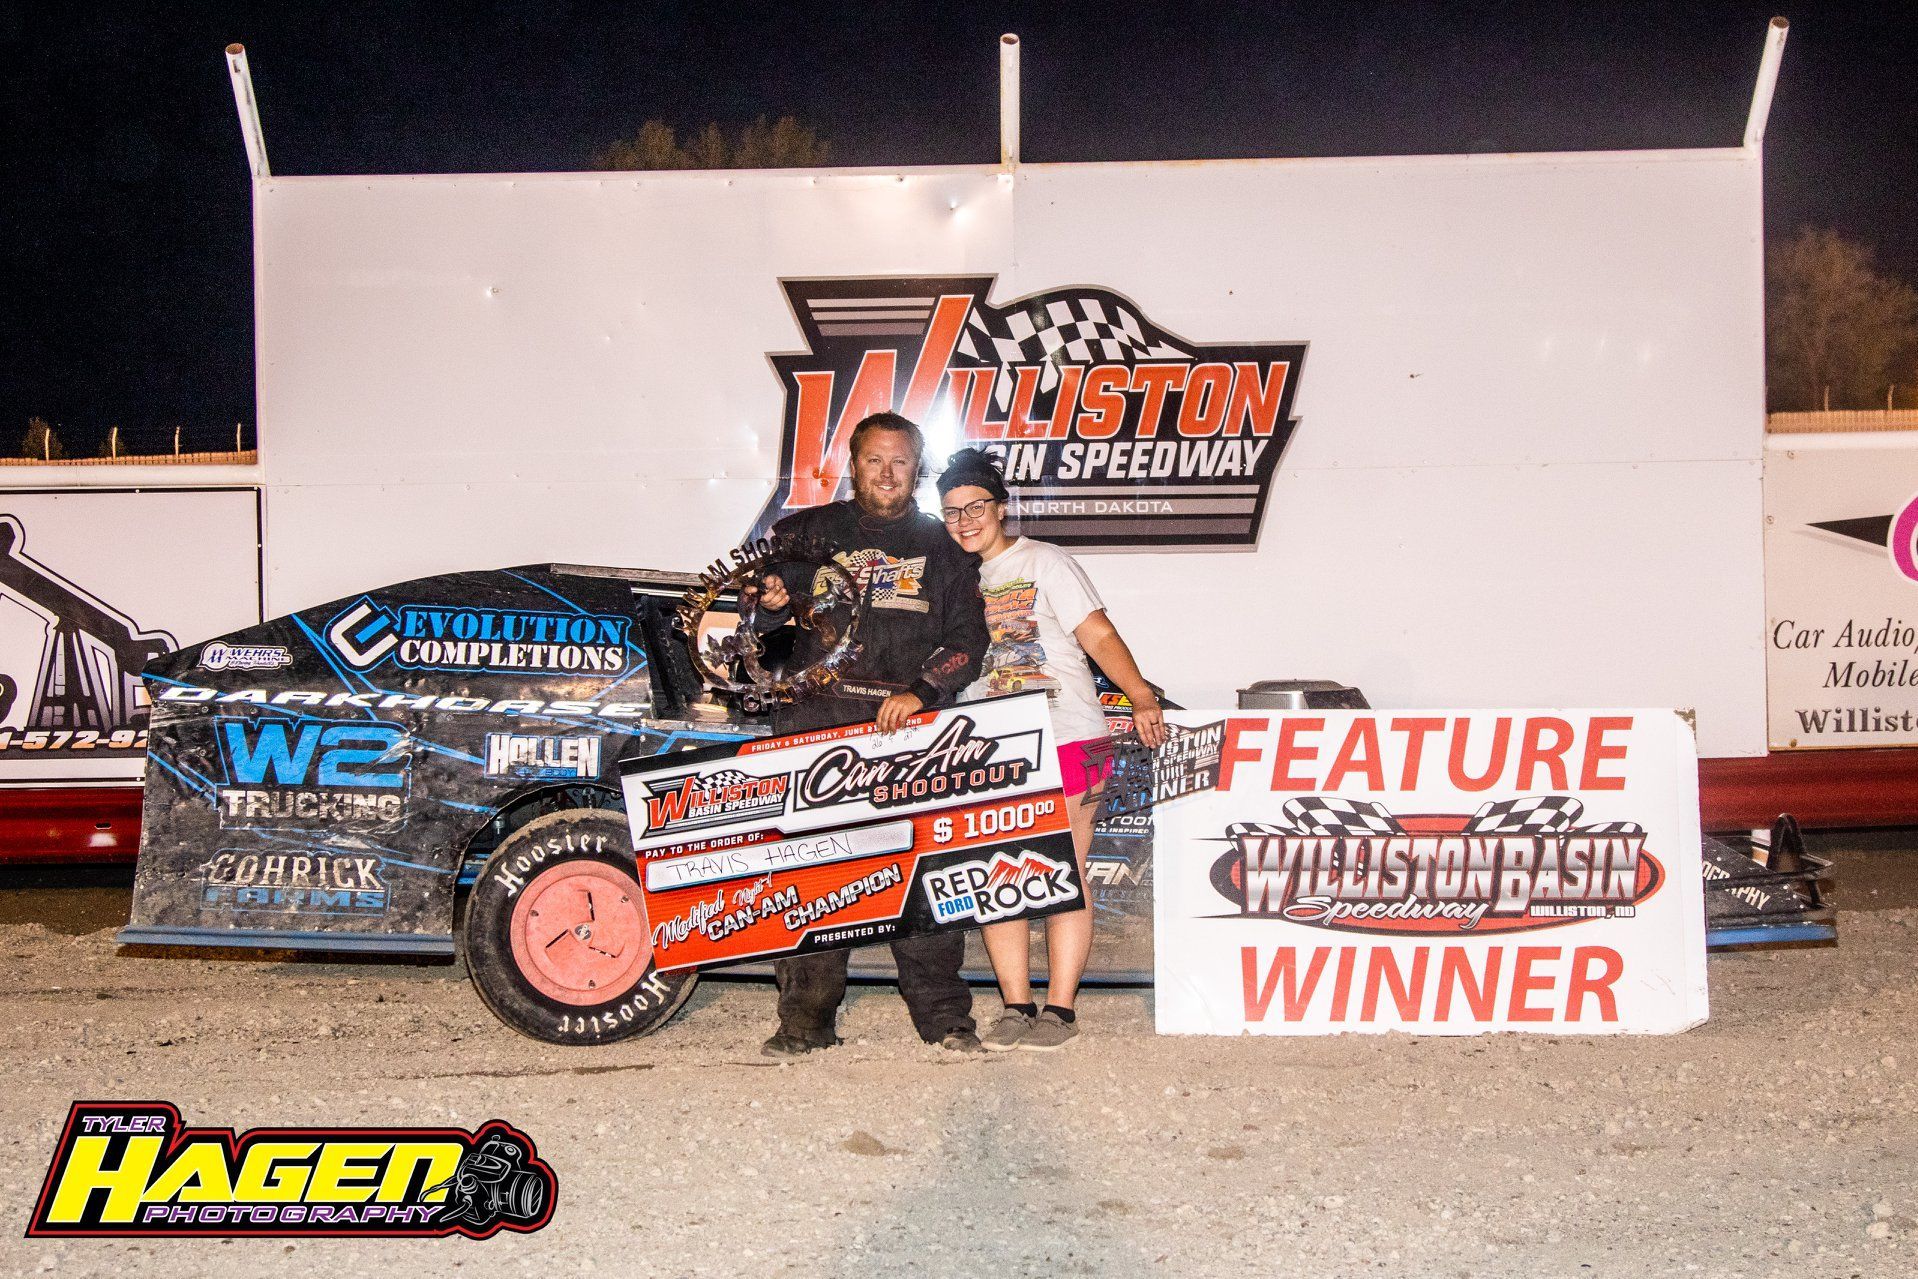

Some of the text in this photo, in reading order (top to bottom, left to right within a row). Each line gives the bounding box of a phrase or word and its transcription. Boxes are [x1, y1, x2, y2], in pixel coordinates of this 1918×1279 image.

[782, 294, 1290, 509] WILLISTON
[1057, 440, 1268, 479] SPEEDWAY
[1019, 501, 1173, 514] NORTH DAKOTA
[403, 611, 624, 645] EVOLUTION
[1773, 619, 1825, 650] Car
[229, 649, 283, 657] WEHRS
[400, 639, 623, 671] COMPLETIONS
[1822, 659, 1918, 688] Mobile
[158, 686, 652, 717] DARKHORSE
[843, 684, 892, 698] TRAVIS HAGEN
[1795, 706, 1918, 734] Willist
[225, 723, 404, 787] W2
[487, 734, 599, 776] HOLLEN
[751, 740, 781, 753] FRIDAY
[844, 728, 864, 739] JUNE
[1214, 716, 1634, 792] FEATURE
[873, 762, 1025, 803] SHOOTOUT
[222, 789, 401, 821] TRUCKING
[648, 775, 788, 830] WILLISTON
[688, 793, 785, 818] BASIN SPEEDWAY
[645, 832, 764, 859] PAY TO THE ORDER OF:
[933, 816, 953, 843] $
[494, 829, 608, 897] Hoosier
[666, 833, 853, 881] TRAVIS HAGEN
[783, 863, 902, 931] CHAMPION
[929, 867, 989, 901] RED
[974, 868, 1071, 916] ROCK
[652, 889, 726, 949] Modified
[706, 885, 799, 941] CAN-AM
[938, 895, 974, 917] FORD
[1282, 893, 1489, 929] Speedway
[1614, 905, 1635, 917] ND
[814, 924, 896, 944] PRESENTED BY:
[1240, 945, 1625, 1022] WINNER
[558, 969, 672, 1039] Hoosier
